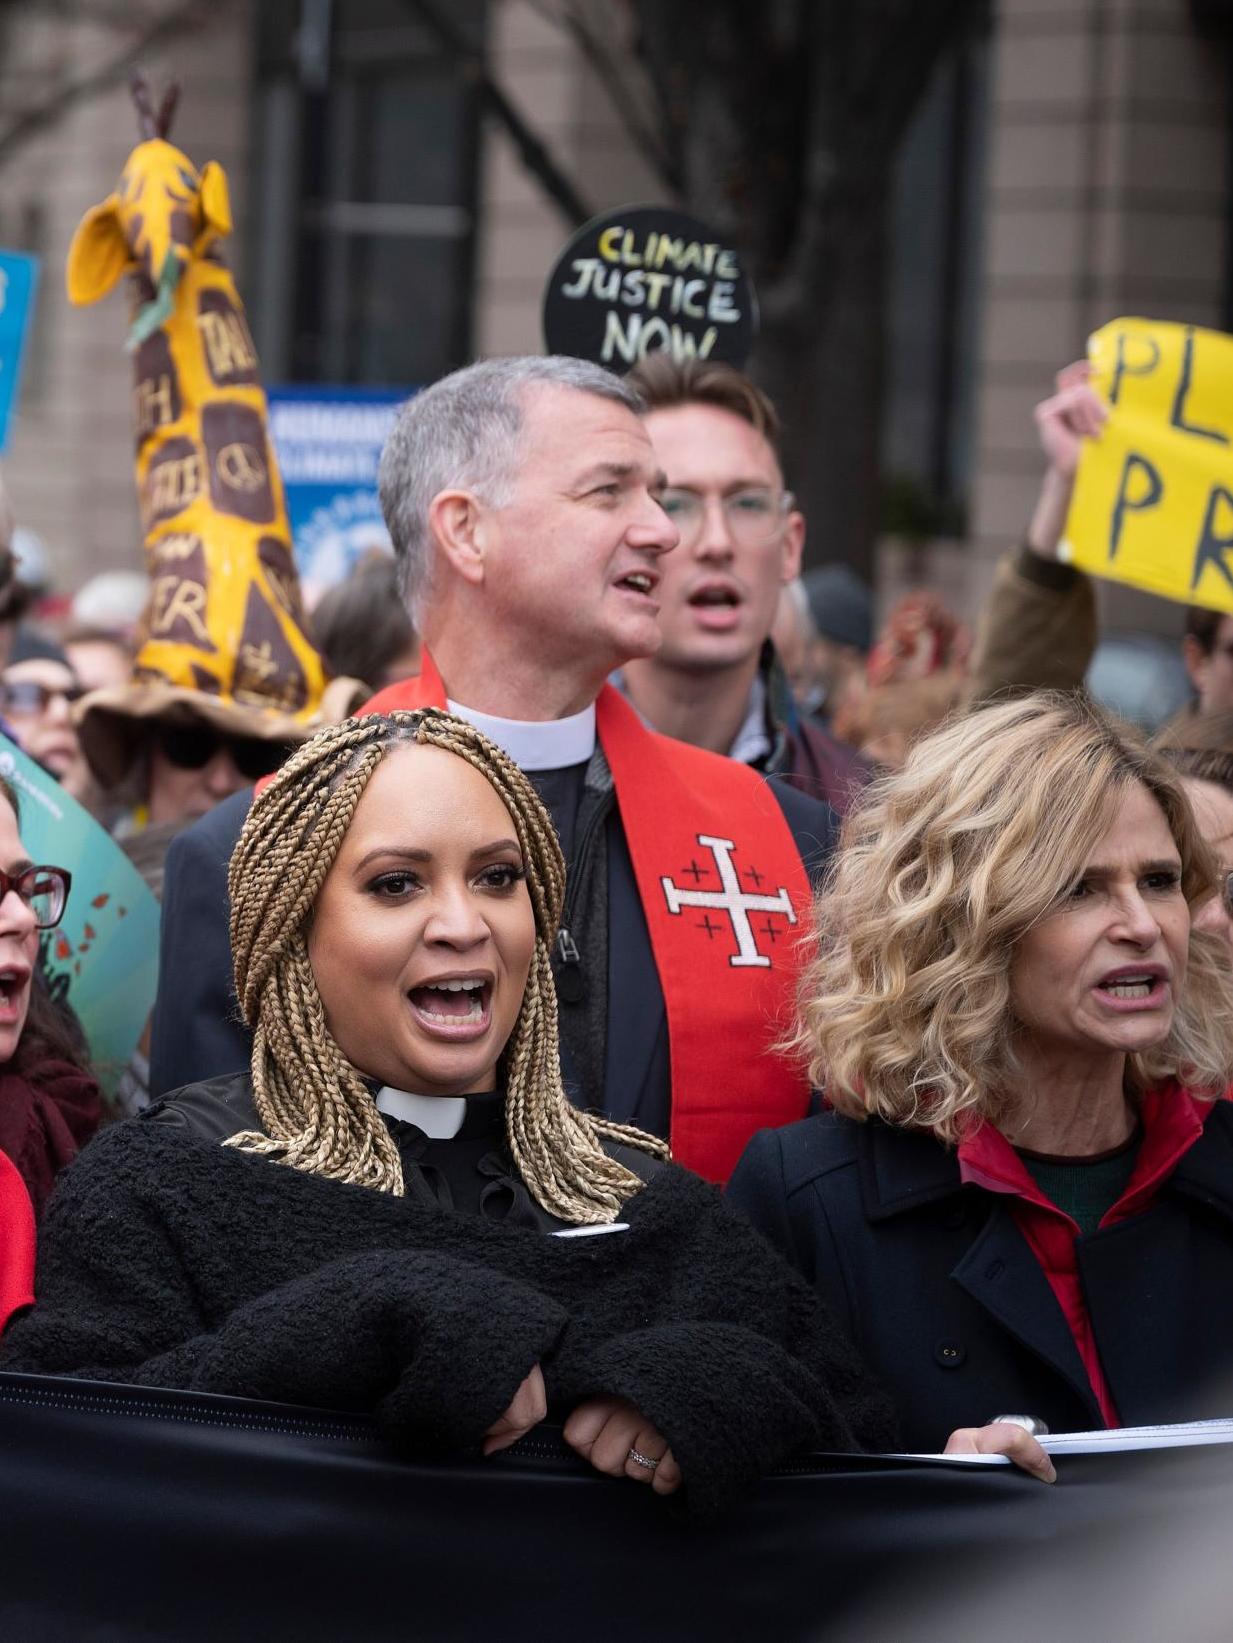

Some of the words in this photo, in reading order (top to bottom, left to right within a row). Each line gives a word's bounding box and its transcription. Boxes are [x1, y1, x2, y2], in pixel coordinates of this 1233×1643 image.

[598, 226, 740, 279] CLIMATE
[561, 258, 741, 323] JUSTICE
[600, 310, 717, 364] NOW
[1108, 450, 1233, 592] PR
